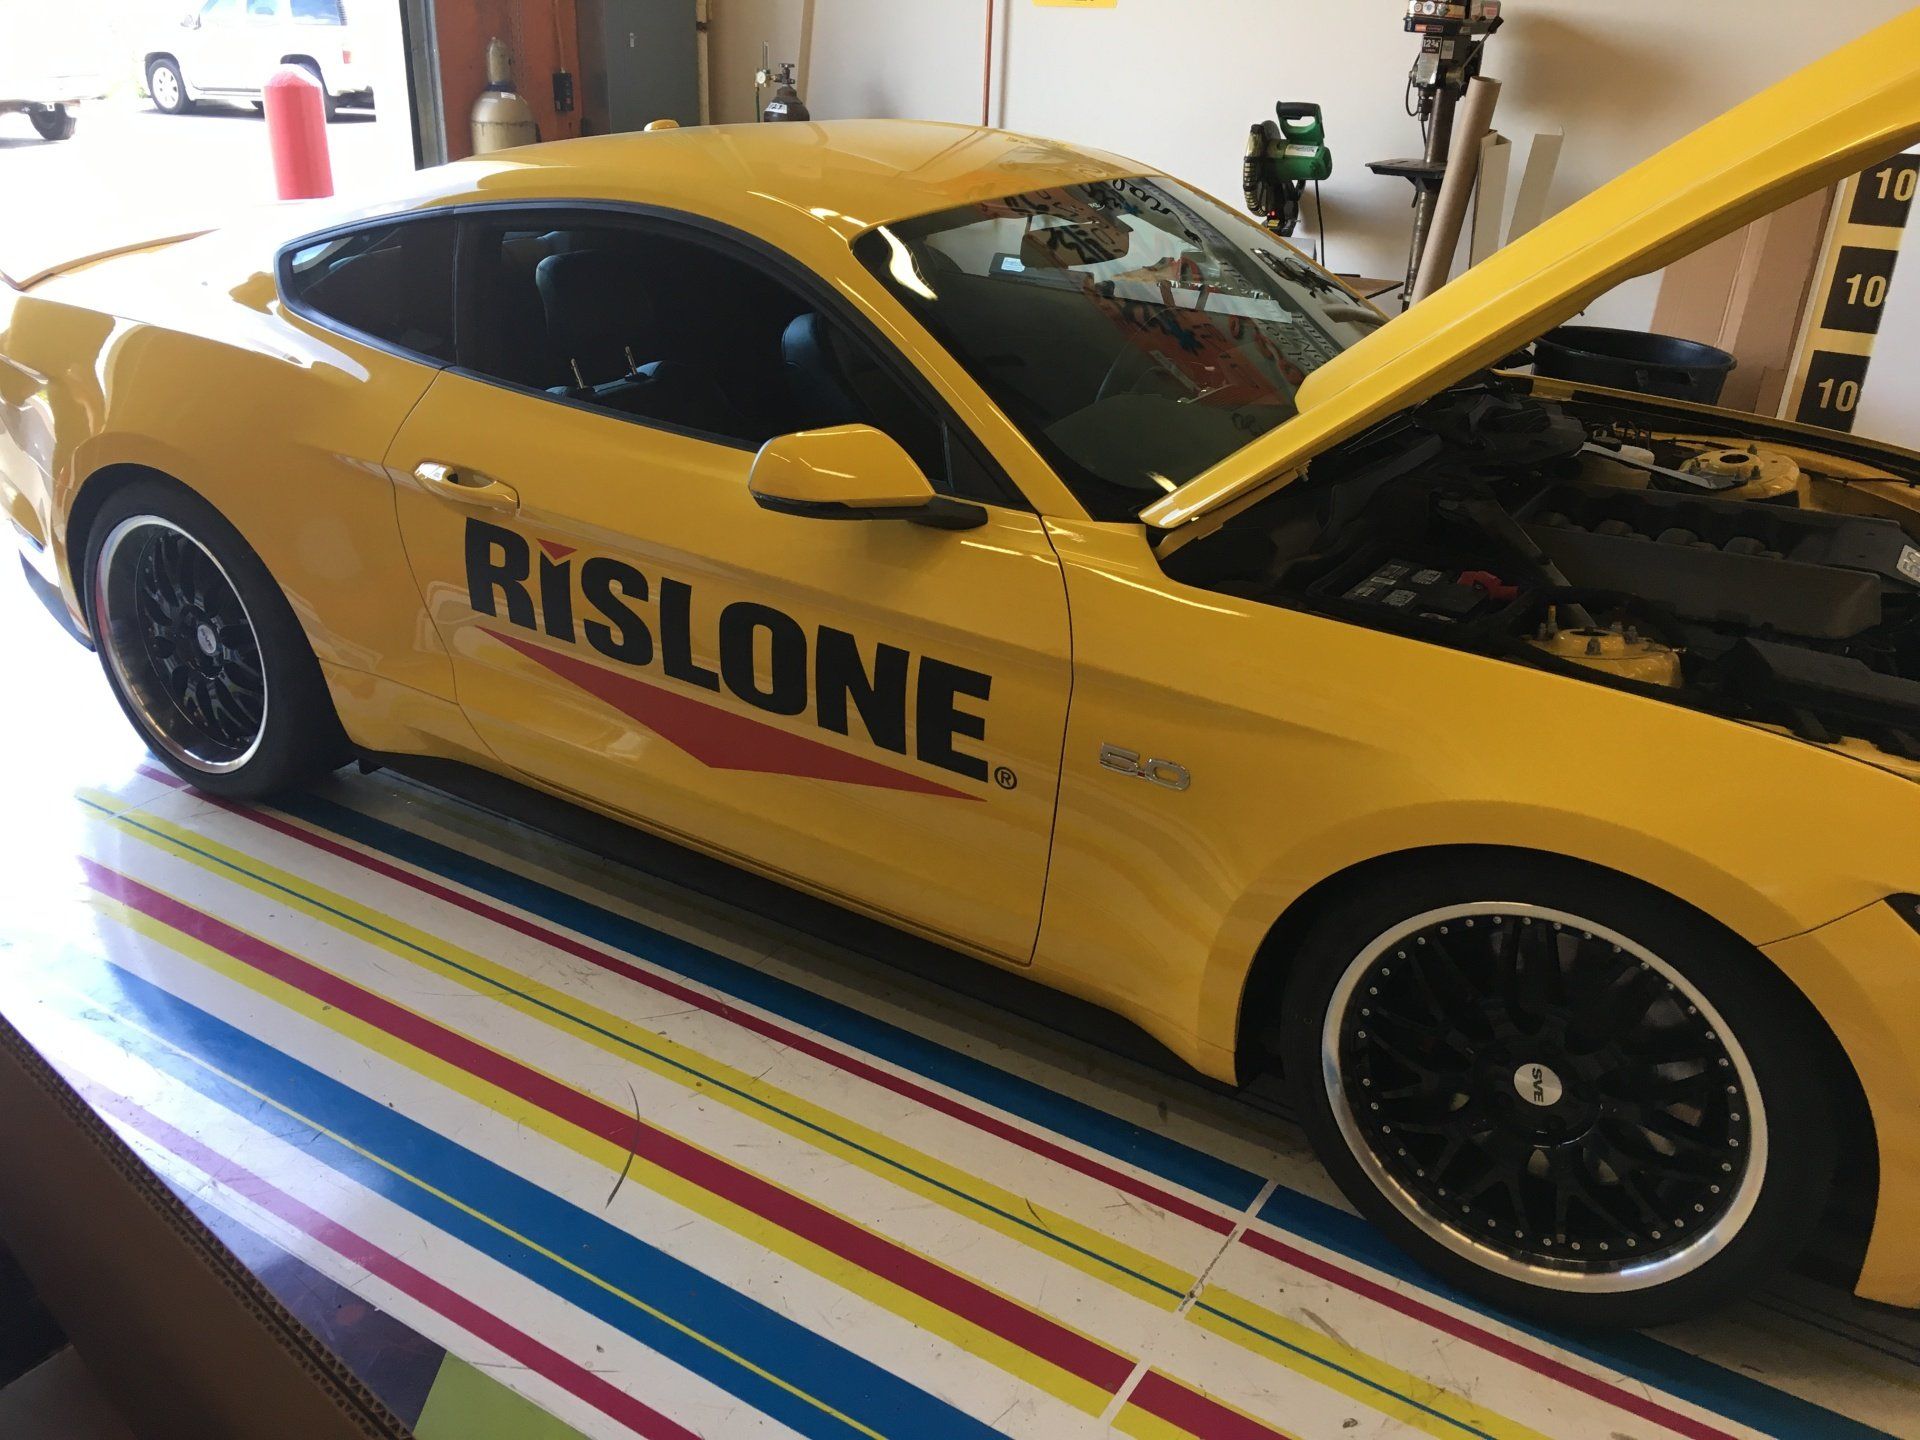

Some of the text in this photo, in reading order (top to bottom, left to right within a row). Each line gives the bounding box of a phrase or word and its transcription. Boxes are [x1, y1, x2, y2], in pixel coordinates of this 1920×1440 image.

[1876, 168, 1917, 201] 10
[1846, 273, 1886, 308] 10
[1818, 378, 1858, 412] 10
[464, 516, 993, 784] RISLONE
[1100, 742, 1190, 791] 5.0
[1532, 1067, 1544, 1103] SVE
